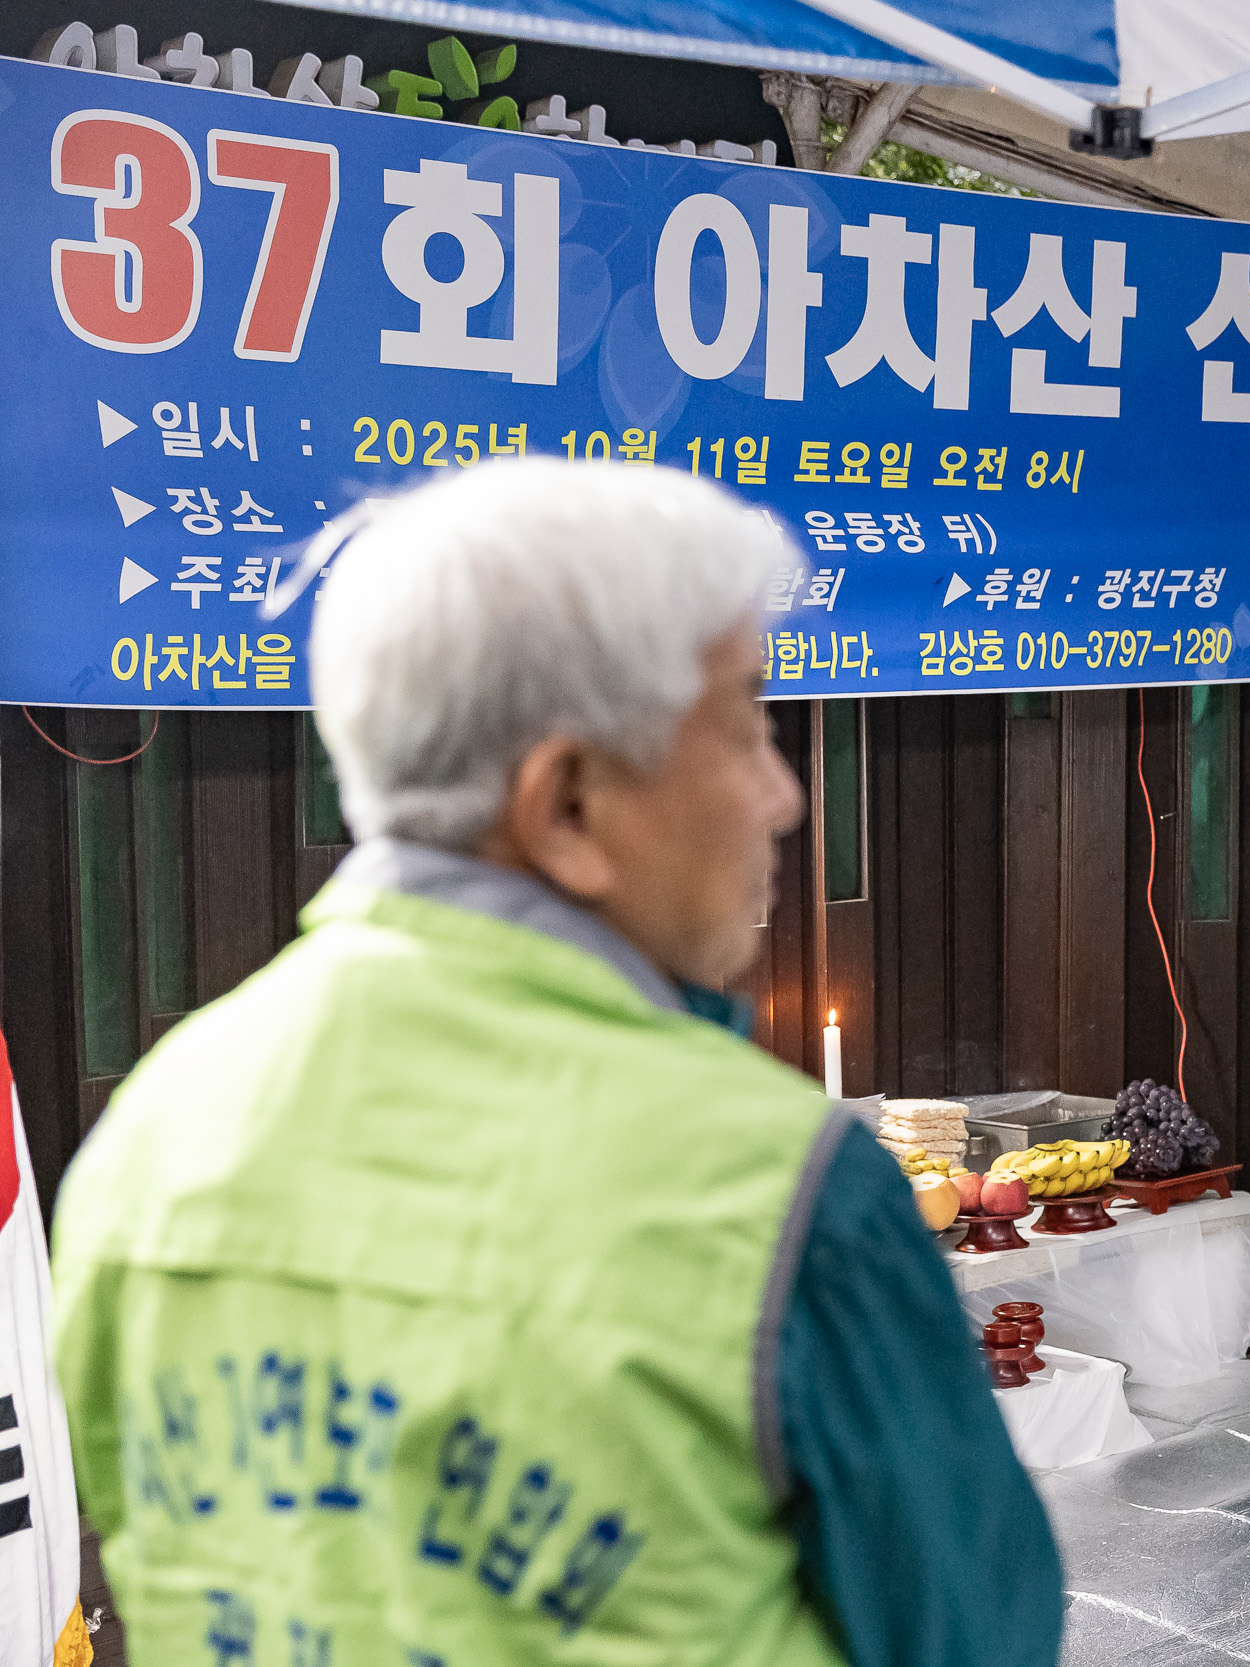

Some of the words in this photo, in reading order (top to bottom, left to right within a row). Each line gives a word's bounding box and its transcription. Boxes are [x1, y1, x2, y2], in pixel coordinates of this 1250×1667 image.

[654, 193, 1137, 417] 아차산
[151, 401, 259, 462] 일시
[353, 416, 528, 468] 2025년
[687, 436, 770, 485] 11일
[794, 441, 912, 489] 토요일
[933, 446, 1008, 491] 오전
[1025, 449, 1084, 493] 8시
[166, 487, 284, 536] 장소
[804, 510, 926, 554] 운동장
[941, 513, 997, 555] 뒤)
[170, 556, 283, 610] 주최
[764, 567, 846, 612] 합회
[976, 567, 1051, 611] 후원
[1097, 567, 1227, 609] 광진구청
[111, 633, 296, 690] 아차산을
[919, 629, 1005, 676] 김상호
[1017, 627, 1233, 671] 010-3797-1280
